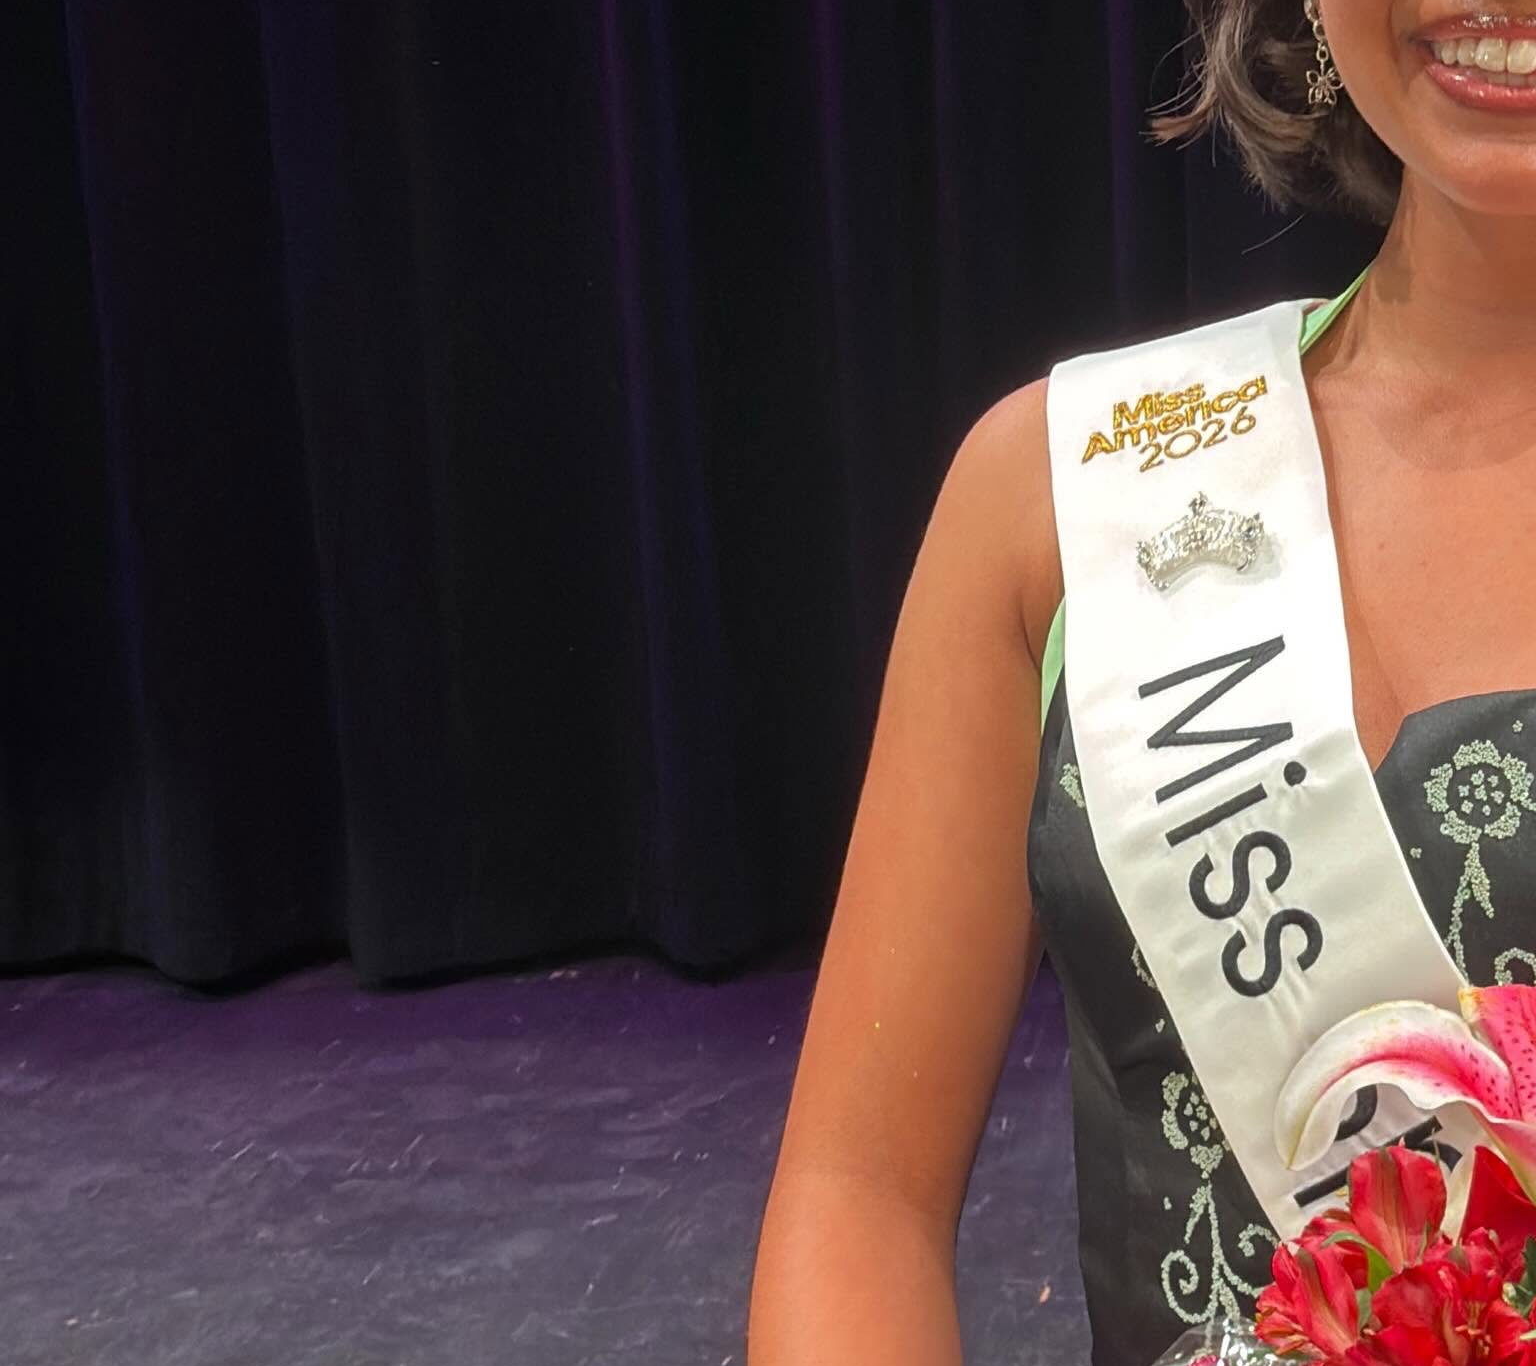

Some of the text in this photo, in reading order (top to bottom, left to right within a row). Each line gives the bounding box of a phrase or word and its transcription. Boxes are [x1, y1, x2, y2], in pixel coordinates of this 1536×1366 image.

[1081, 376, 1268, 464] America
[1113, 383, 1206, 429] Miss
[1139, 406, 1257, 473] 2026
[1137, 635, 1324, 998] Miss
